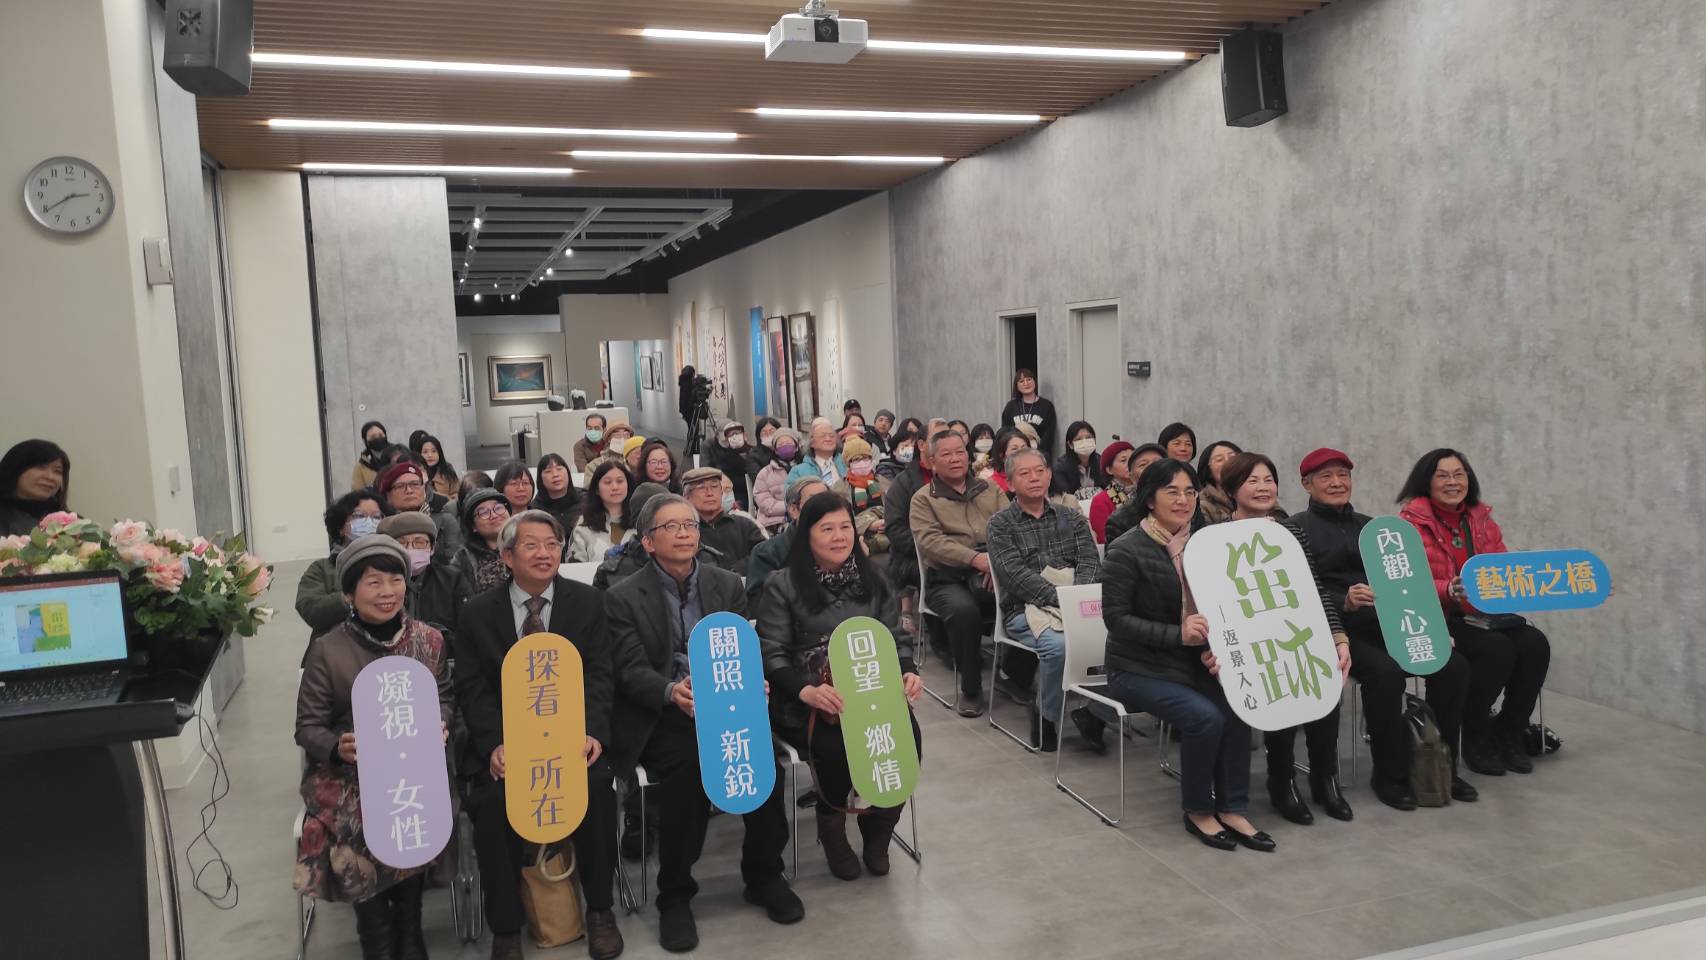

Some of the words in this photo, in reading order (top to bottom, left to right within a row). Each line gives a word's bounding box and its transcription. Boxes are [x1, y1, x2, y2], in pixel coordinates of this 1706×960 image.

[51, 168, 58, 178] 11
[65, 166, 74, 175] 12
[83, 170, 87, 179] 1
[40, 178, 49, 187] 10
[94, 179, 100, 189] 2
[37, 191, 44, 199] 9
[99, 193, 104, 202] 3
[42, 205, 49, 213] 8
[95, 207, 101, 215] 4
[55, 214, 61, 223] 7
[85, 216, 91, 225] 5
[70, 219, 76, 228] 6
[1473, 560, 1598, 601] 藝術之橋
